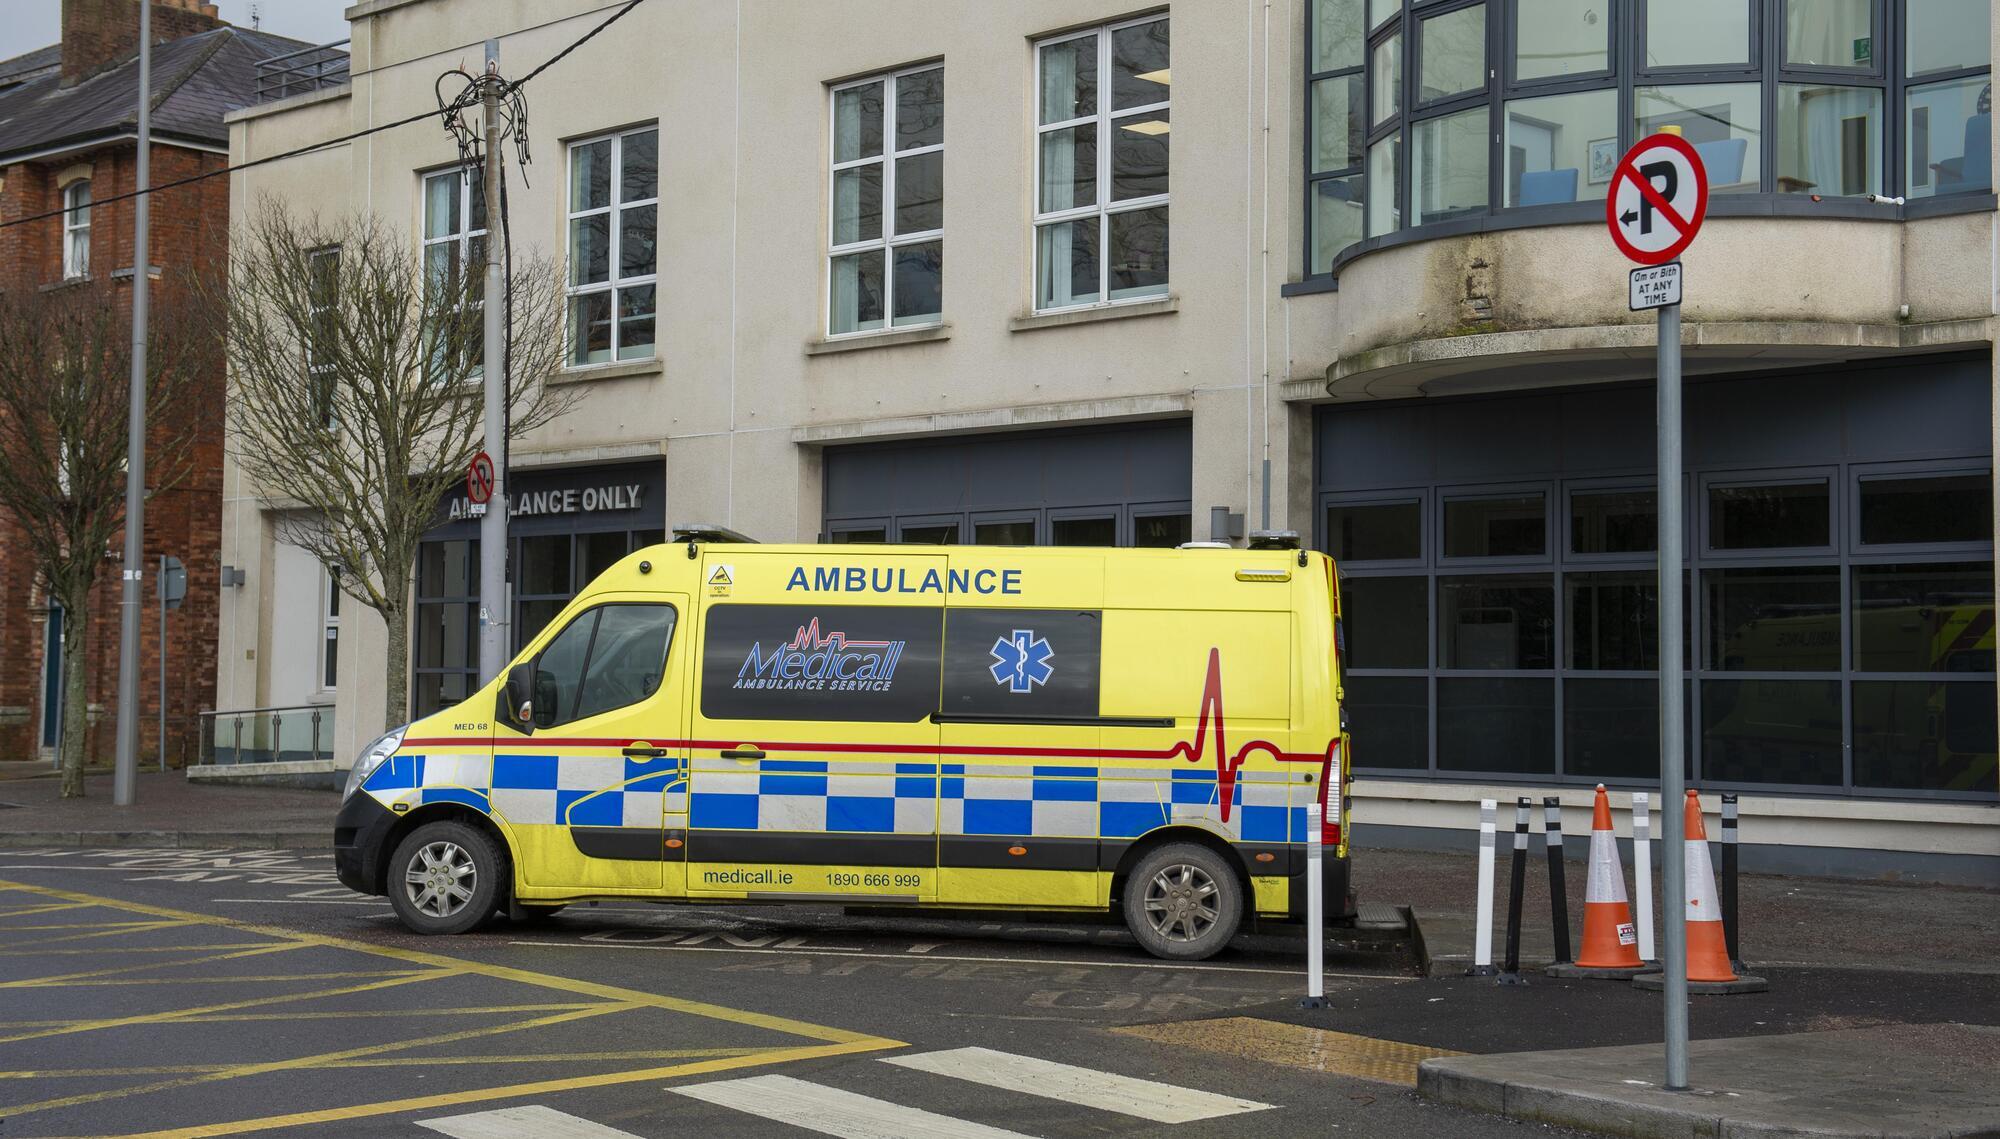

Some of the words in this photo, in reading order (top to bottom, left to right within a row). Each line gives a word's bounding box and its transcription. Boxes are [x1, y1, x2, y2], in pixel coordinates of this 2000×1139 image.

[1640, 160, 1678, 234] P
[1638, 283, 1650, 294] AT
[1653, 279, 1673, 292] ANY
[1644, 292, 1667, 305] TIME
[582, 484, 641, 512] ONLY
[786, 566, 1022, 594] AMBULANCE
[738, 640, 906, 681] Medicall
[733, 679, 826, 691] AMBULANCE
[829, 680, 893, 692] SERVICE
[454, 723, 475, 731] MED
[477, 723, 488, 731] 68
[703, 868, 793, 885] medicall.ie
[826, 873, 860, 886] 1890
[864, 874, 890, 887] 666
[894, 875, 921, 888] 999
